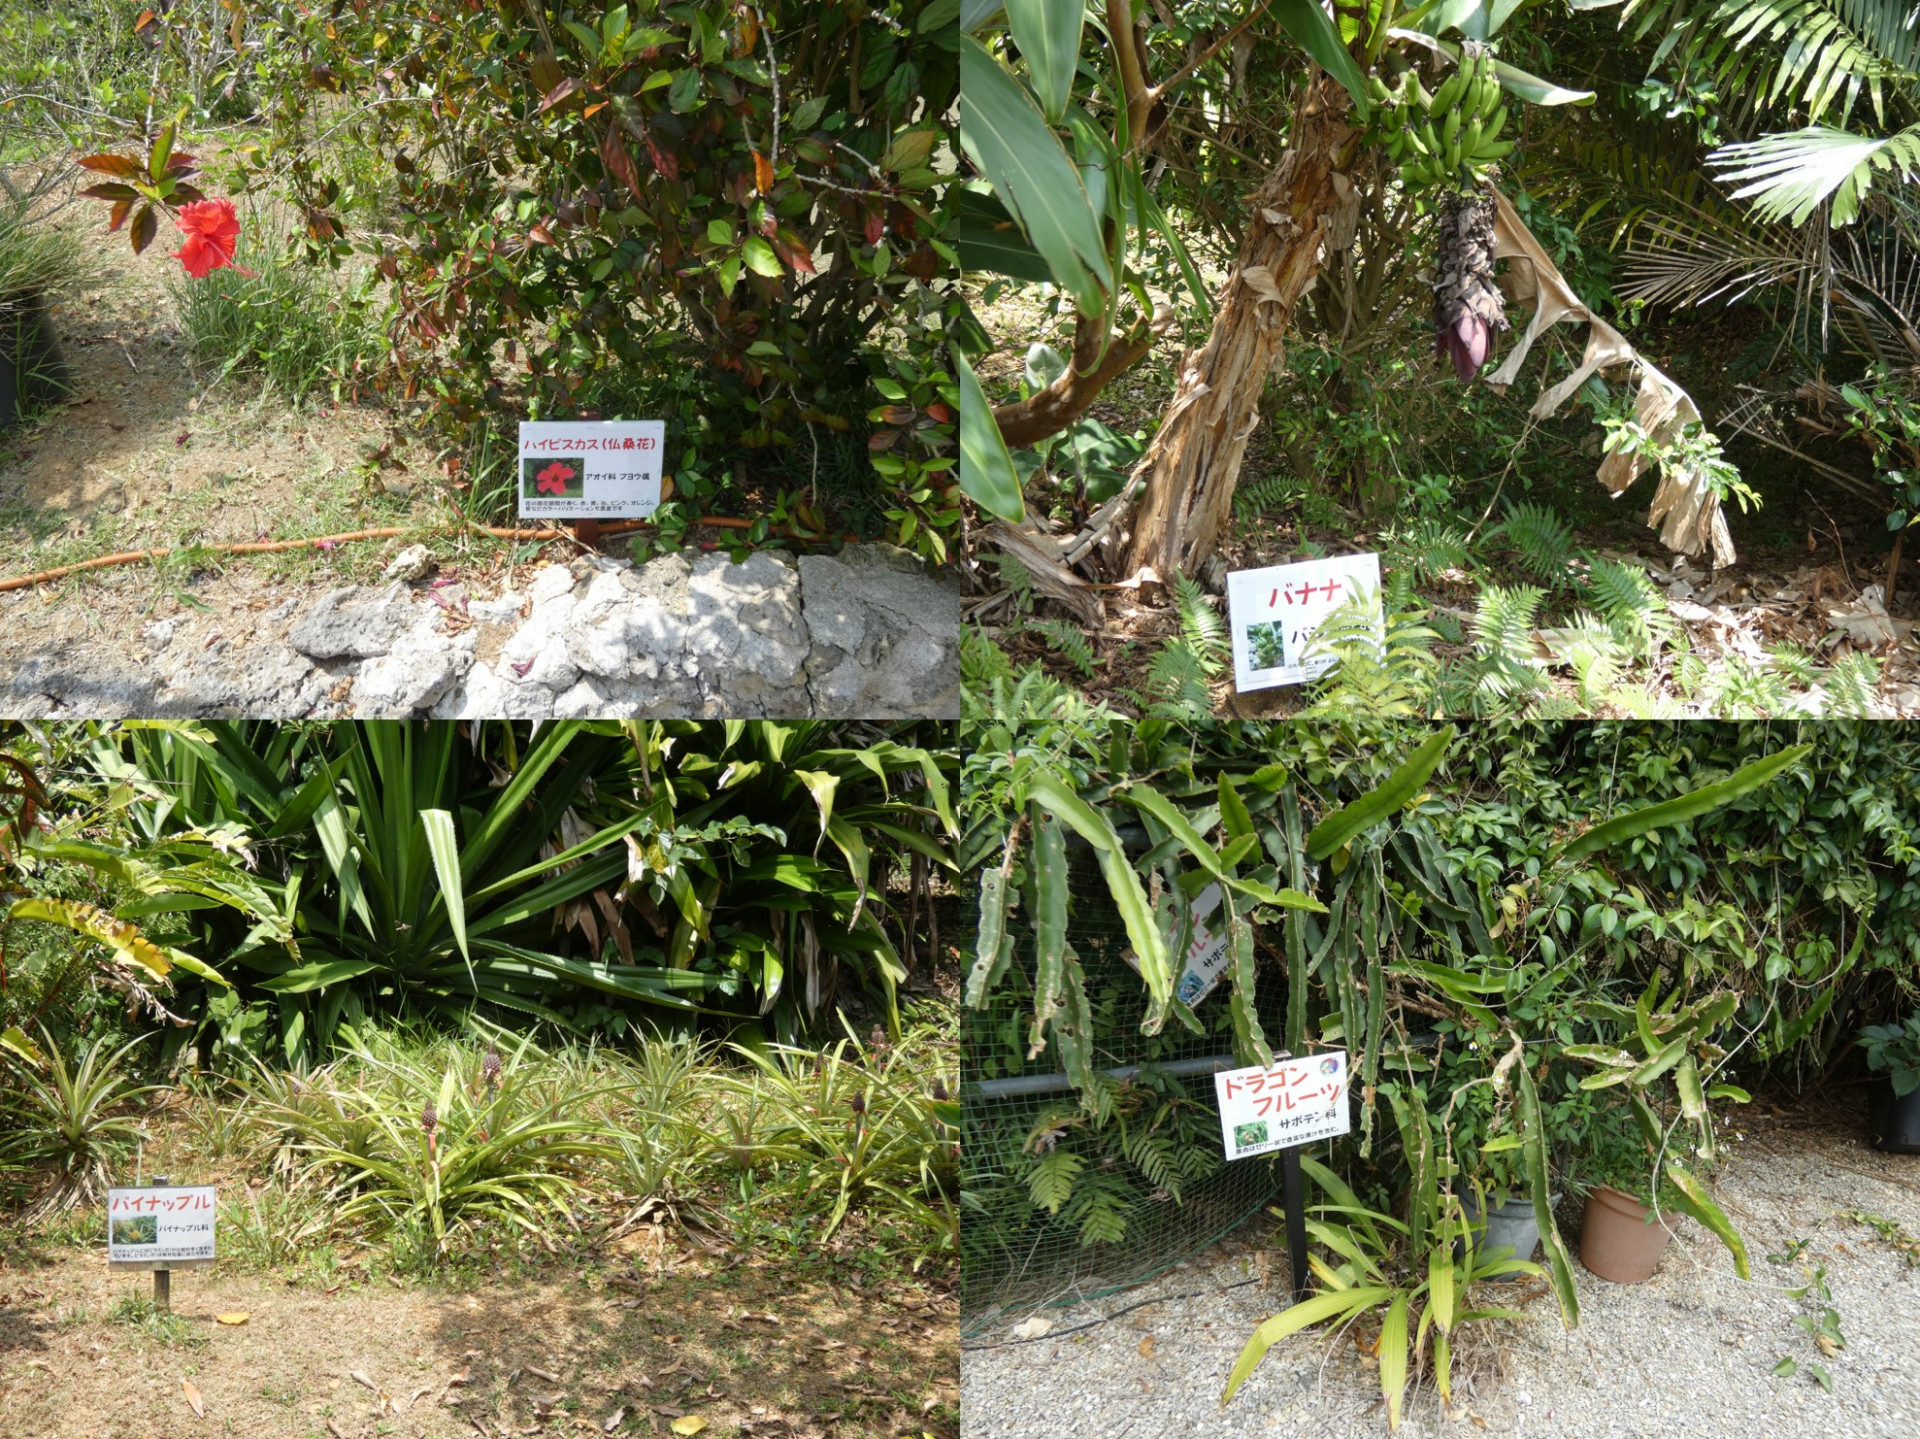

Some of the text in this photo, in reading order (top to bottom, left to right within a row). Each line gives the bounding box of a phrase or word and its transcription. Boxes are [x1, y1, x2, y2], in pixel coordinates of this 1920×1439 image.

[524, 437, 656, 451] ハイビスカス(仏桑花)
[586, 473, 650, 481] アオイ科 フヨウ属
[1269, 578, 1342, 608] バナナ
[1226, 1067, 1308, 1100] ドラゴン
[1253, 1083, 1339, 1117] フルーツ
[1279, 1107, 1337, 1129] サボテン科
[112, 1194, 211, 1212] パイナップル
[159, 1224, 209, 1233] パイナップル科
